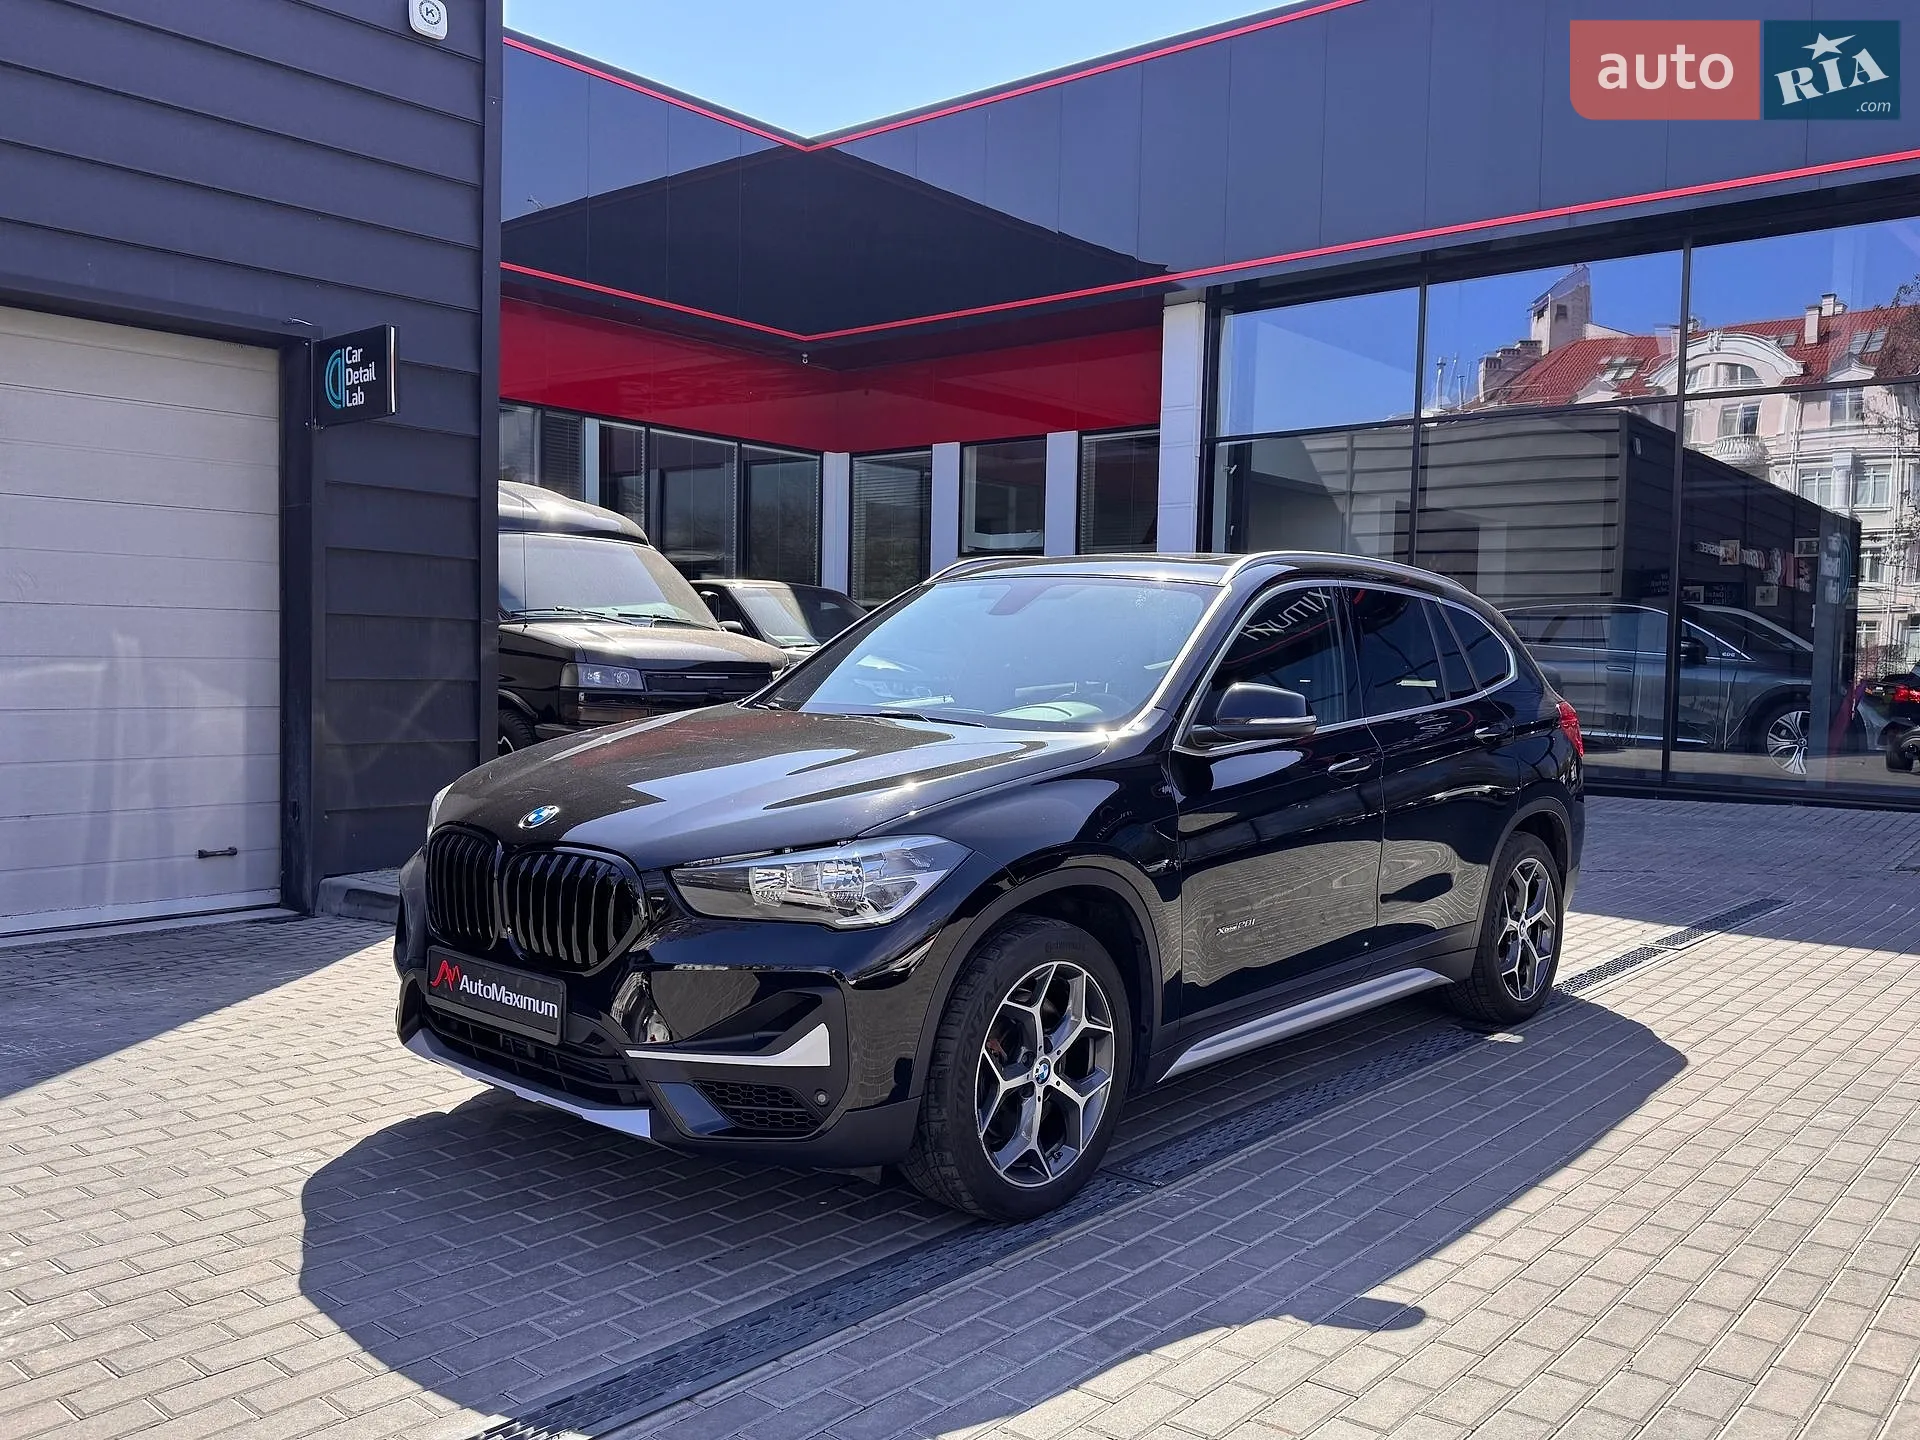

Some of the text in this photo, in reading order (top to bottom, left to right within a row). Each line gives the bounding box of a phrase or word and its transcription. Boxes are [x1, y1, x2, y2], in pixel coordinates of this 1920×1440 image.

[345, 346, 363, 364] Car
[345, 361, 376, 386] Detail
[346, 386, 365, 407] Lab
[459, 974, 558, 1019] AutoMaximum
